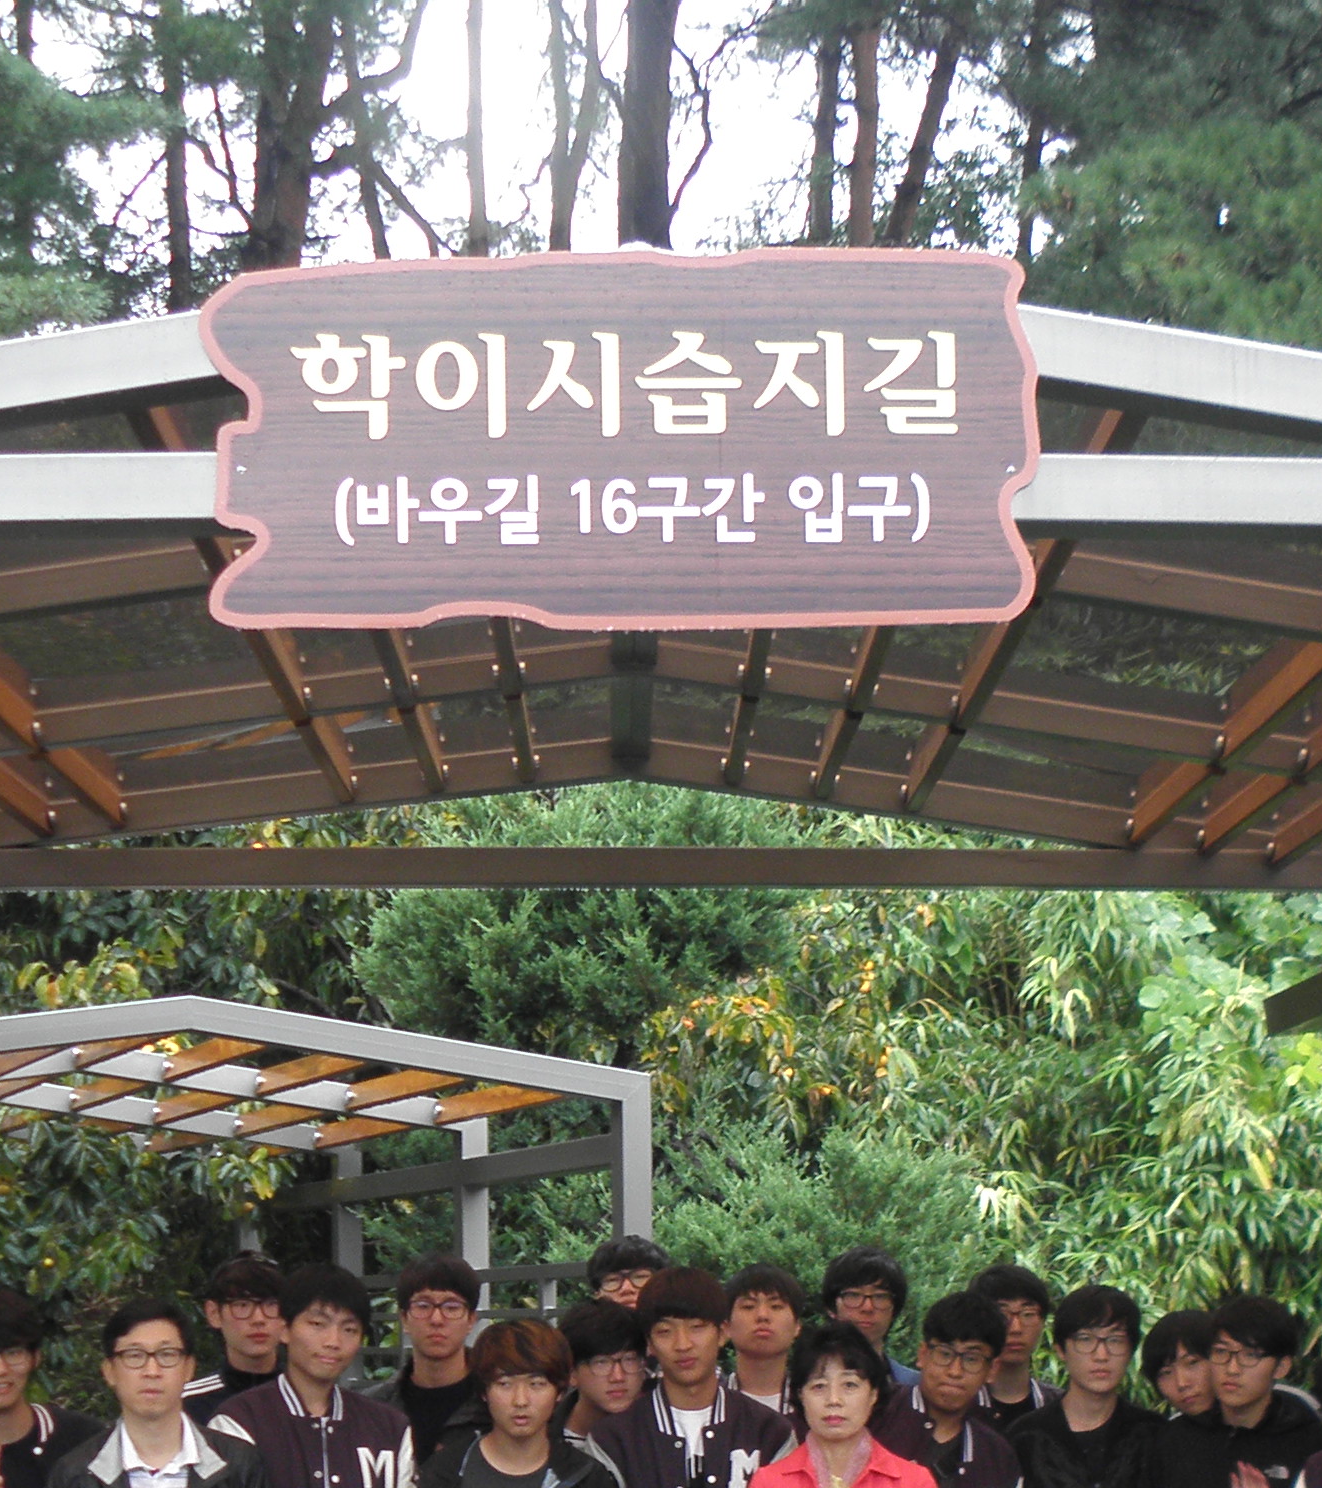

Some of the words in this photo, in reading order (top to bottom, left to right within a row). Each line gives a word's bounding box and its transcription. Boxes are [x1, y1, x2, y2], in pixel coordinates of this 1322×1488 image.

[290, 330, 960, 440] 학이시습지길
[334, 474, 540, 546] (바우길
[570, 473, 765, 544] 16구간
[789, 472, 931, 544] 입구)
